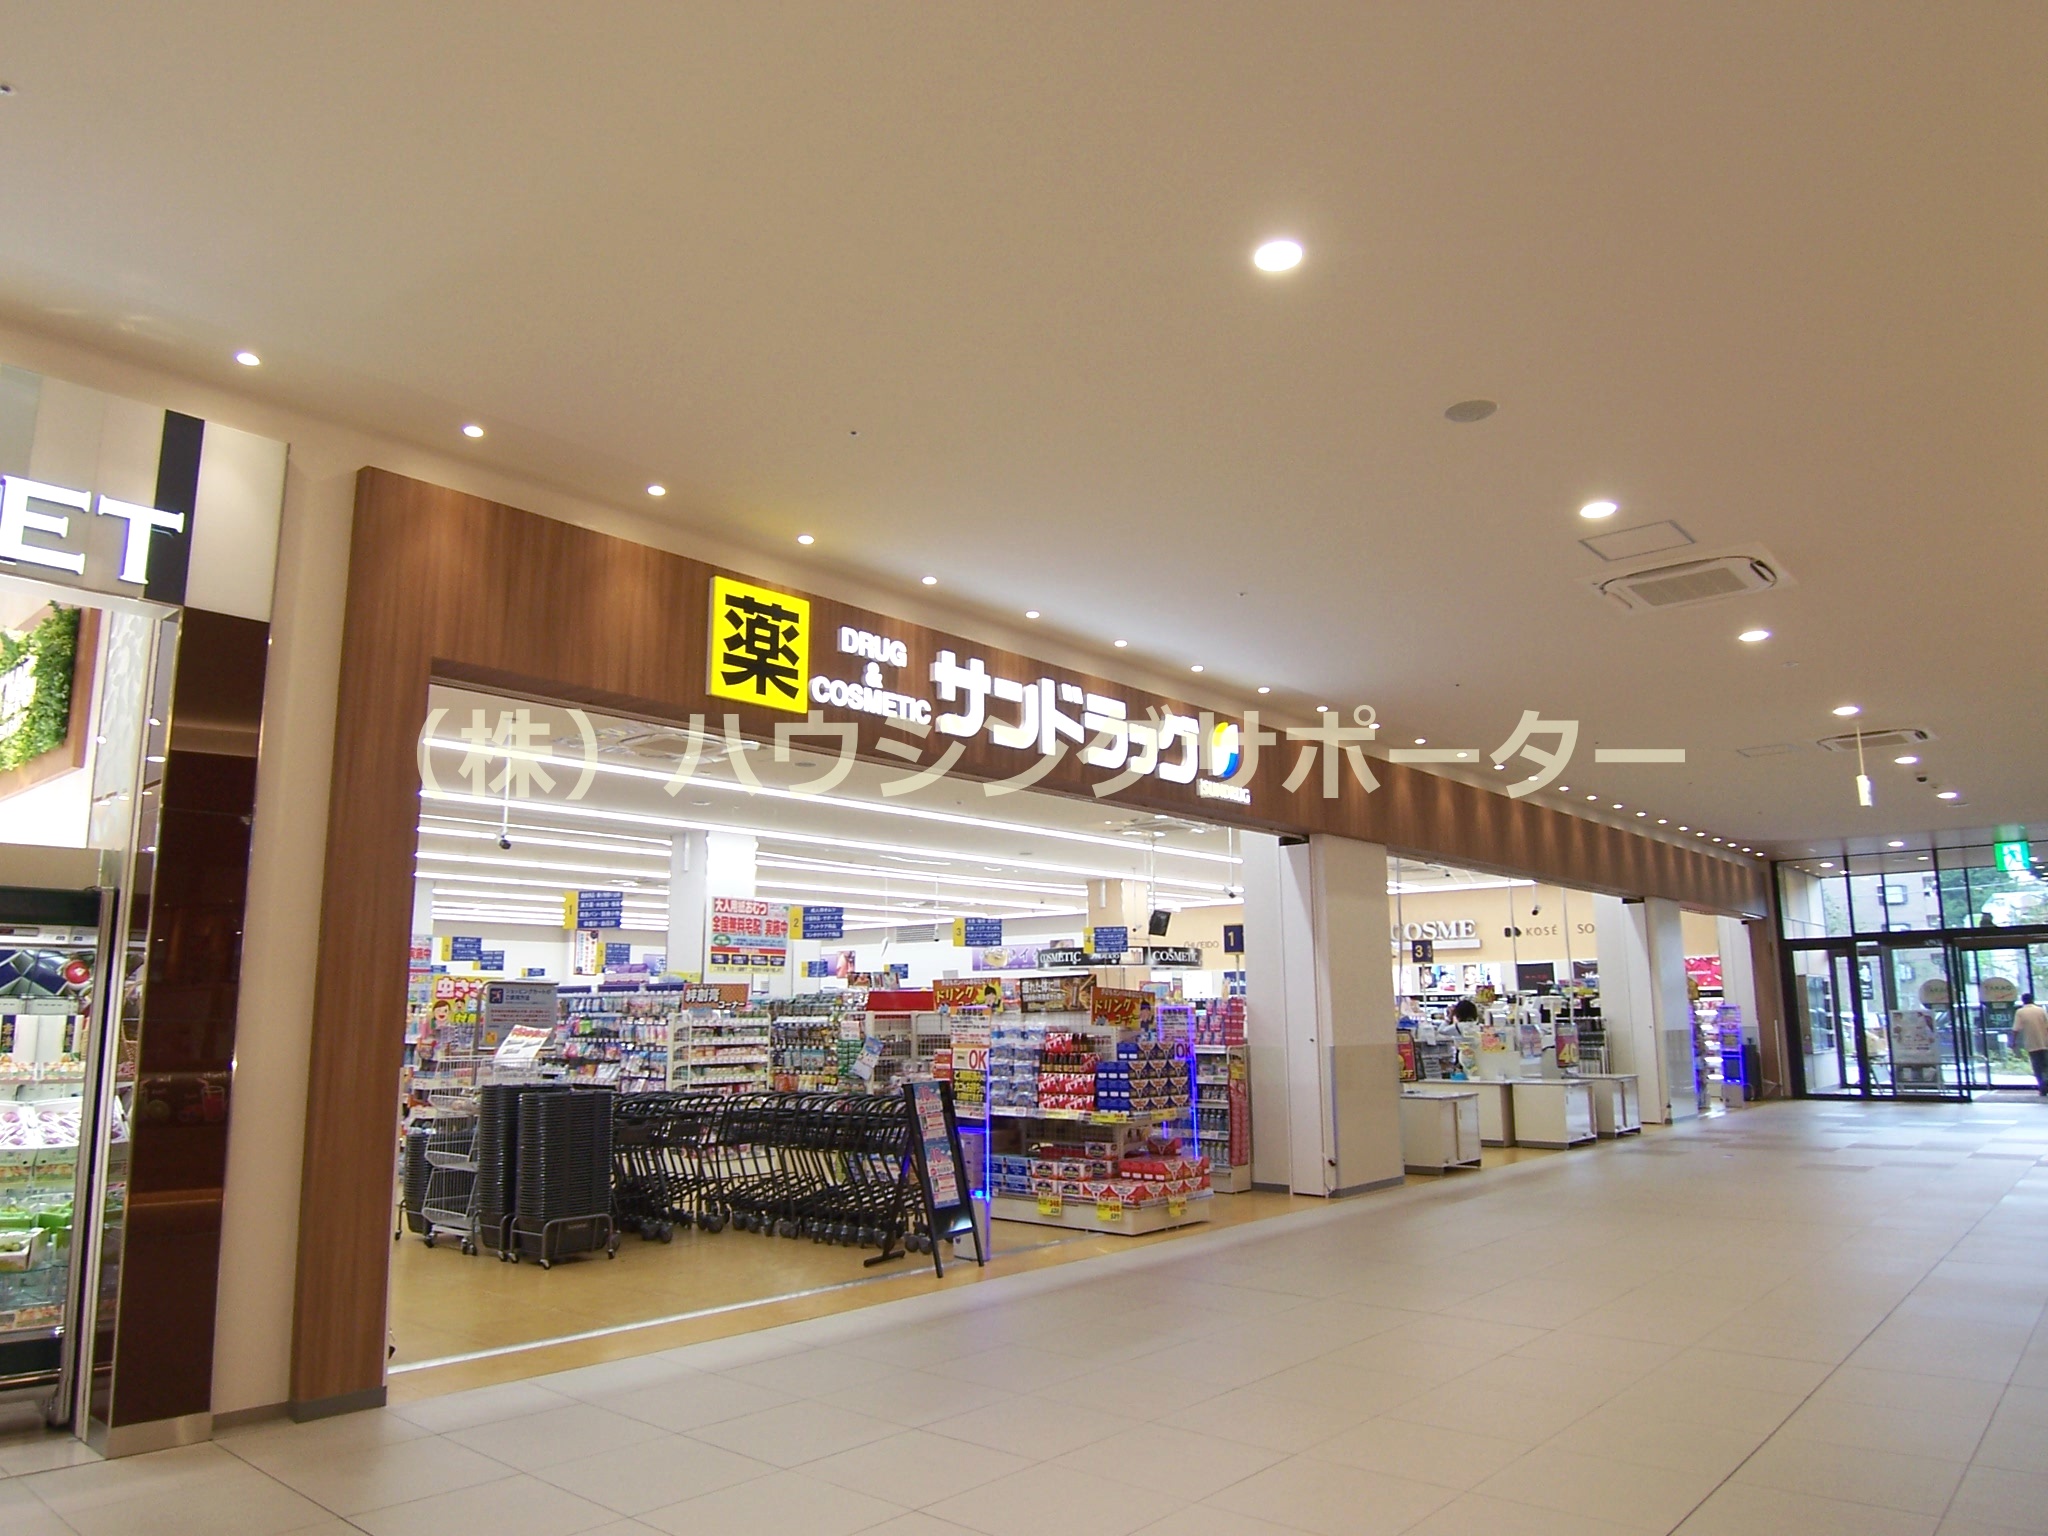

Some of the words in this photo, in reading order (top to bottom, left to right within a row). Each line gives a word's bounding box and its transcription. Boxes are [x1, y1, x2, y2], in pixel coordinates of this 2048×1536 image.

[721, 594, 800, 699] 薬
[837, 625, 908, 668] DRUG
[863, 661, 884, 690] &
[810, 674, 932, 726] COSMETIC
[931, 650, 1201, 784] サンドラッグ
[1227, 931, 1235, 947] 1
[1415, 944, 1424, 958] 3
[936, 986, 974, 1004] ドリンク
[1094, 998, 1132, 1014] ドリンク
[968, 1049, 988, 1070] OK
